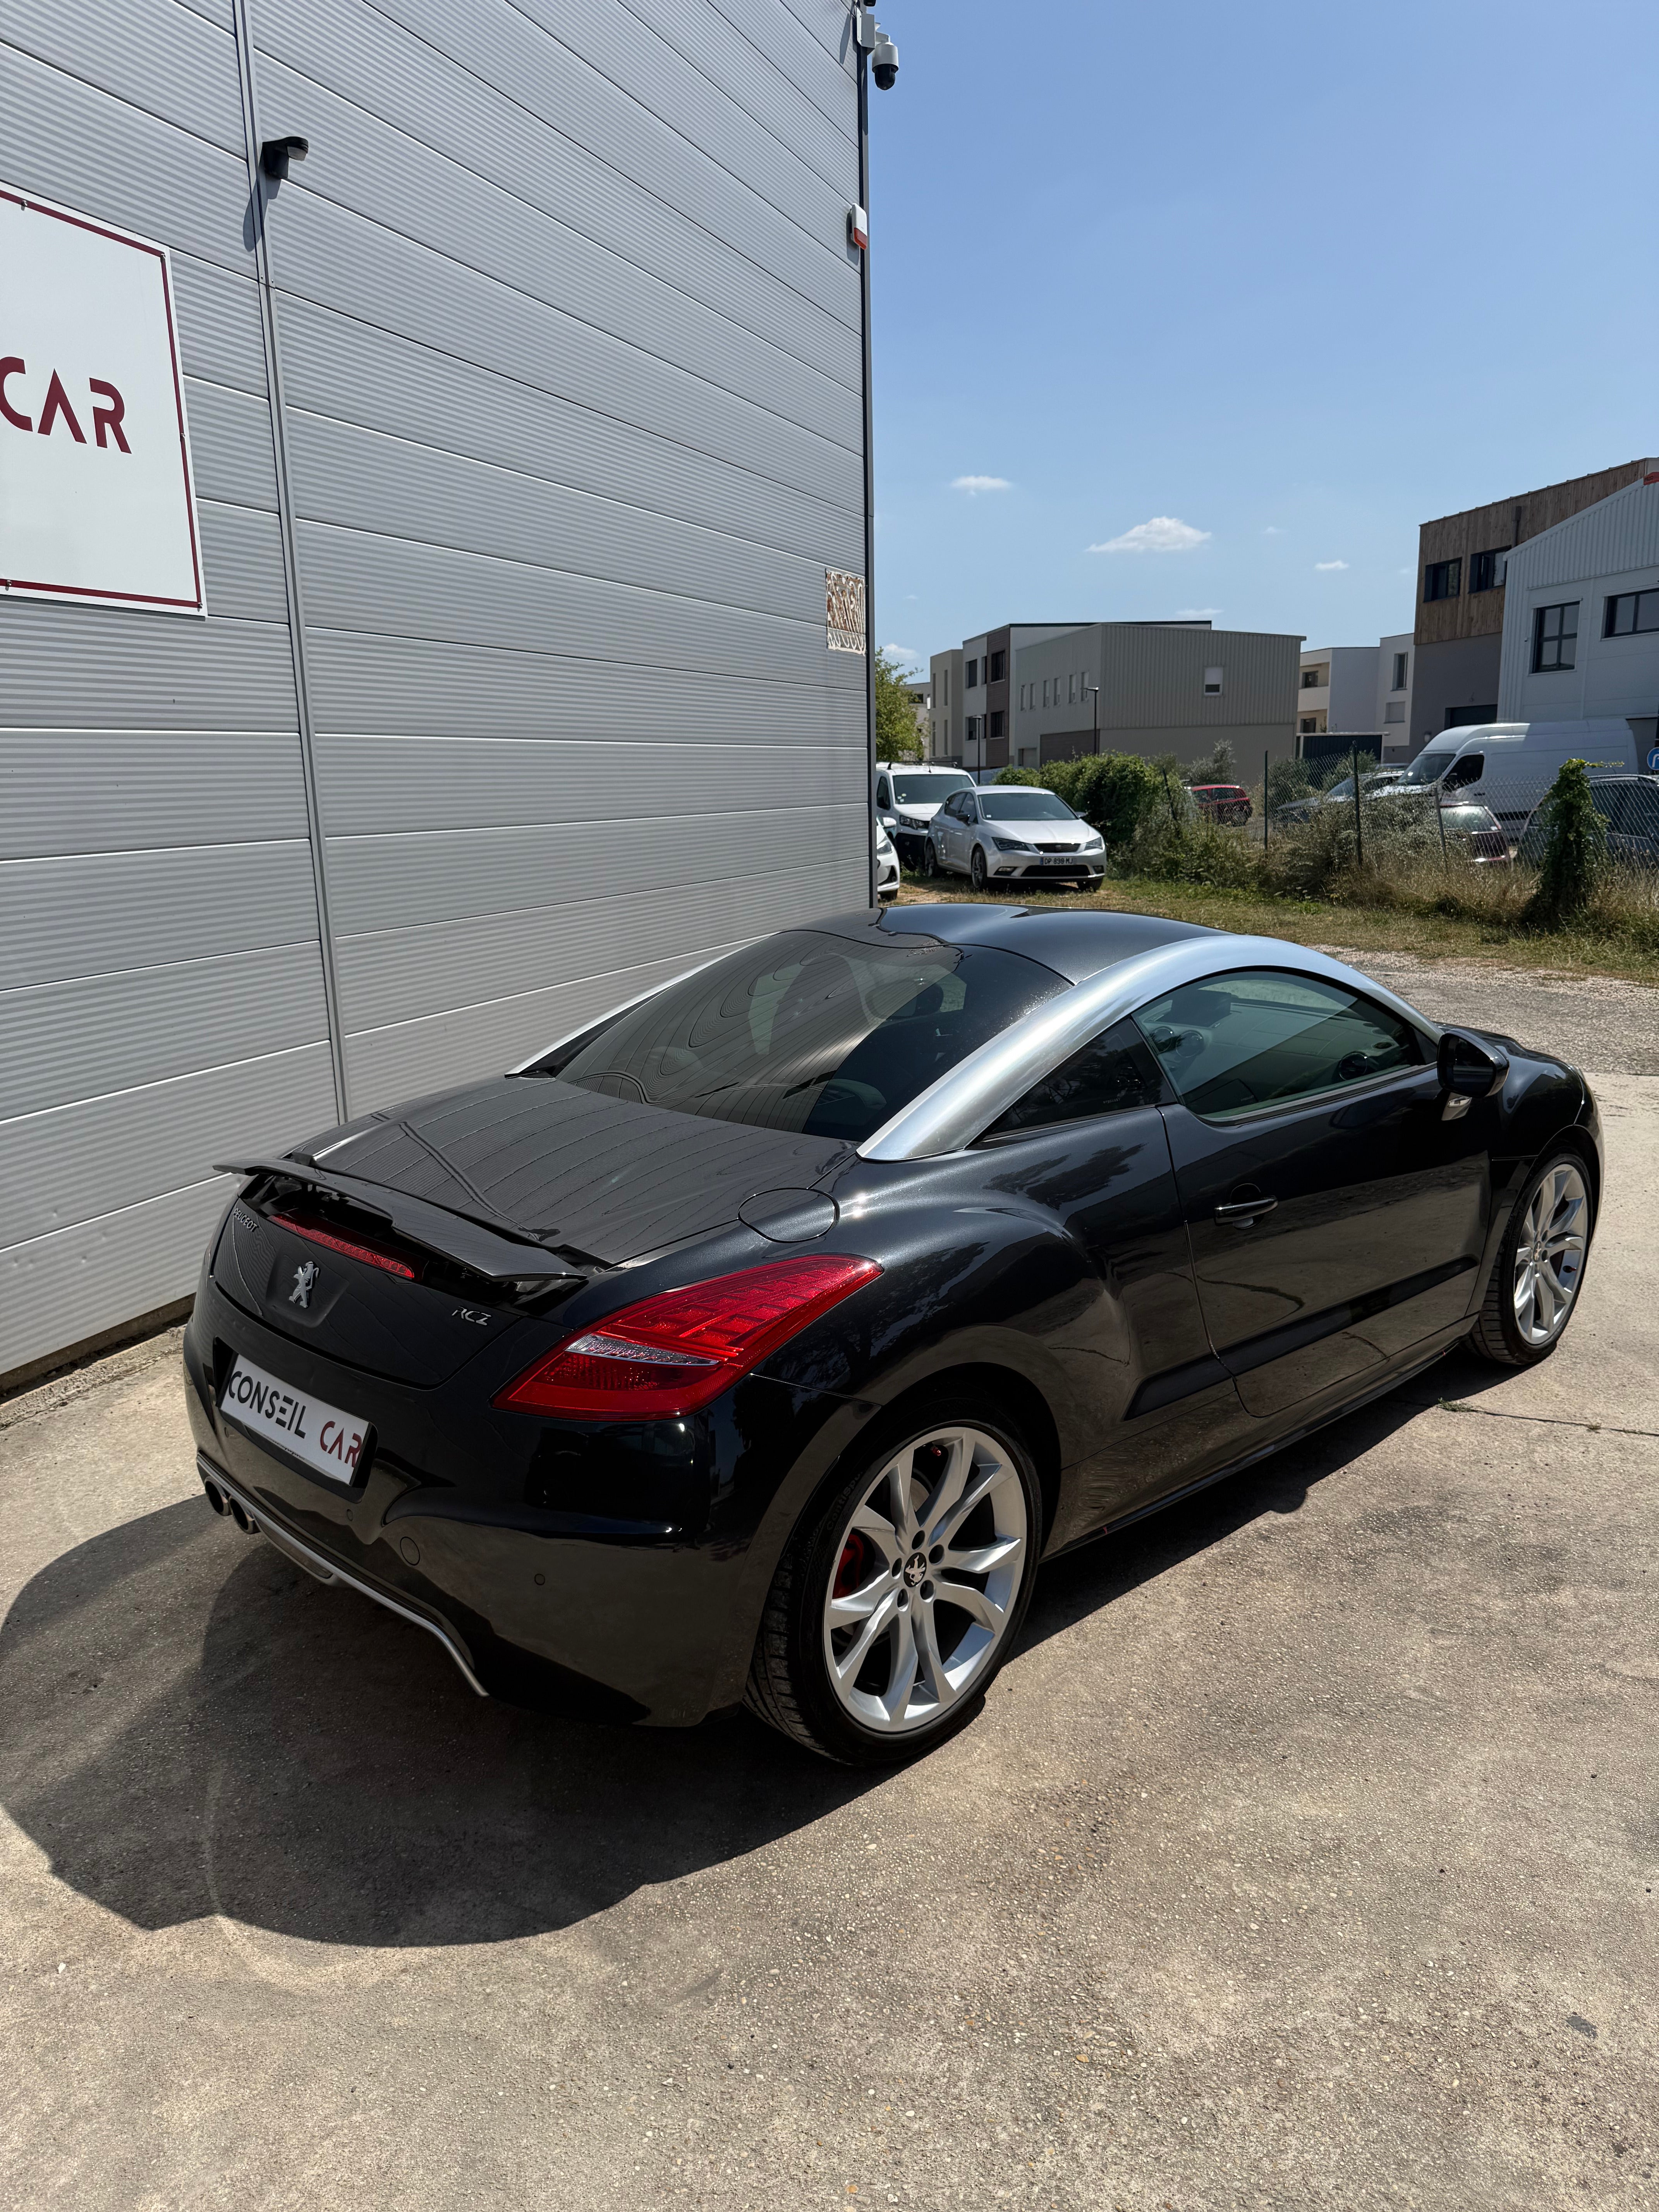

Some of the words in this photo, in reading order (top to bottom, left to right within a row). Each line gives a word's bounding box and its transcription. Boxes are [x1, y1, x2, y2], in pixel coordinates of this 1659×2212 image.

[0, 357, 132, 454] CAR
[233, 1208, 257, 1231] PEUGEOT
[452, 1306, 491, 1326] RCZ
[228, 1371, 306, 1439] CONSEIL
[320, 1421, 362, 1468] CAR
